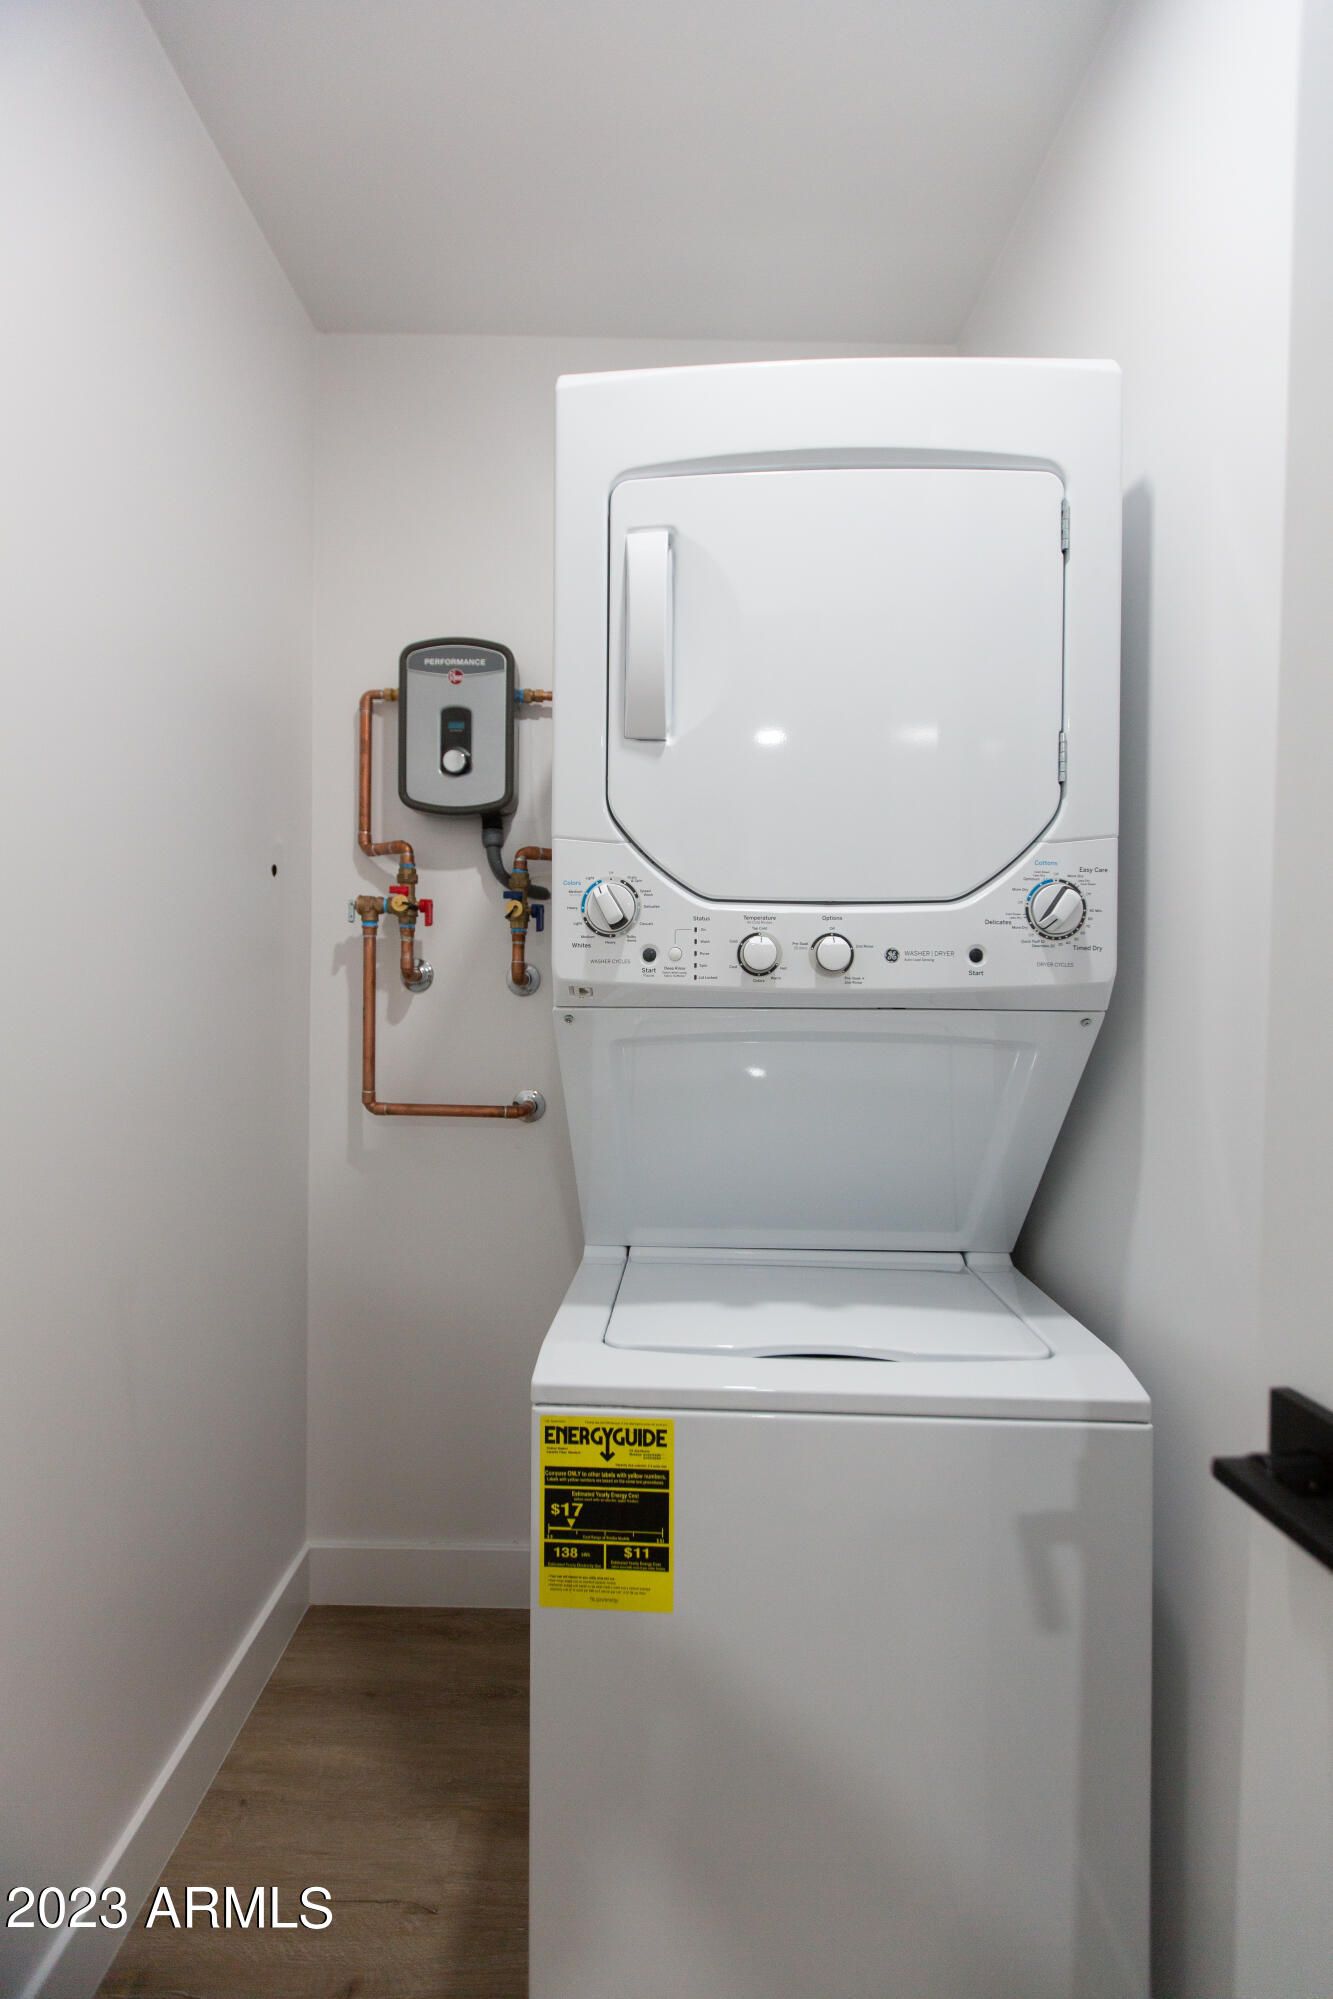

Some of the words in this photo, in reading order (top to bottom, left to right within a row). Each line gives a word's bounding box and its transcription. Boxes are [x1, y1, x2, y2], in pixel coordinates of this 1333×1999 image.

[545, 1426, 667, 1448] ENERGYGUIDE
[551, 1502, 583, 1517] $17
[554, 1547, 578, 1558] 138
[624, 1547, 649, 1559] $11
